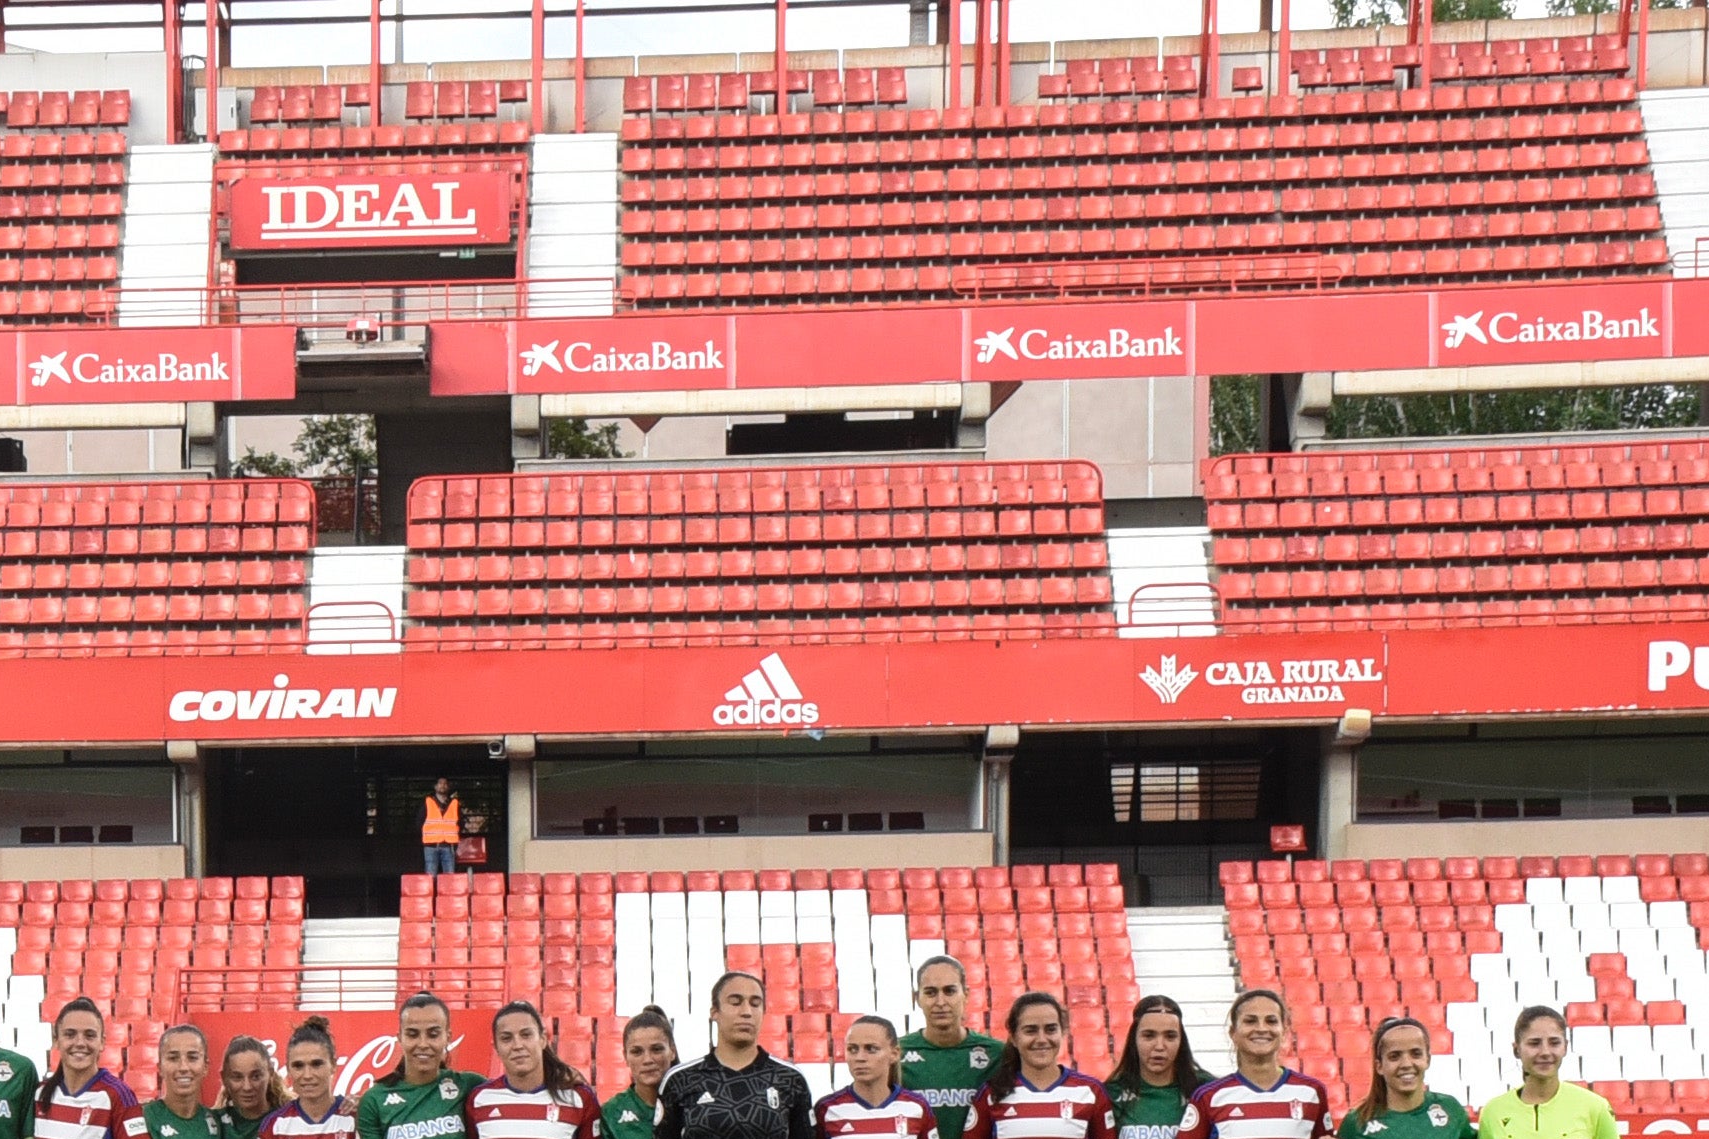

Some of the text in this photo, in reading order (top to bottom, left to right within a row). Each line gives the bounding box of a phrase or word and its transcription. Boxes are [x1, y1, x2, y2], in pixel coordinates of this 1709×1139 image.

[261, 181, 476, 227] IDEAL
[1488, 307, 1659, 344] CaixaBank
[564, 340, 724, 373] CaixaBank
[1019, 327, 1183, 361] CaixaBank
[72, 351, 230, 384] CaixaBank
[1205, 657, 1382, 687] CAJA RURAL
[1241, 684, 1345, 704] GRANADA
[712, 697, 819, 725] adidas
